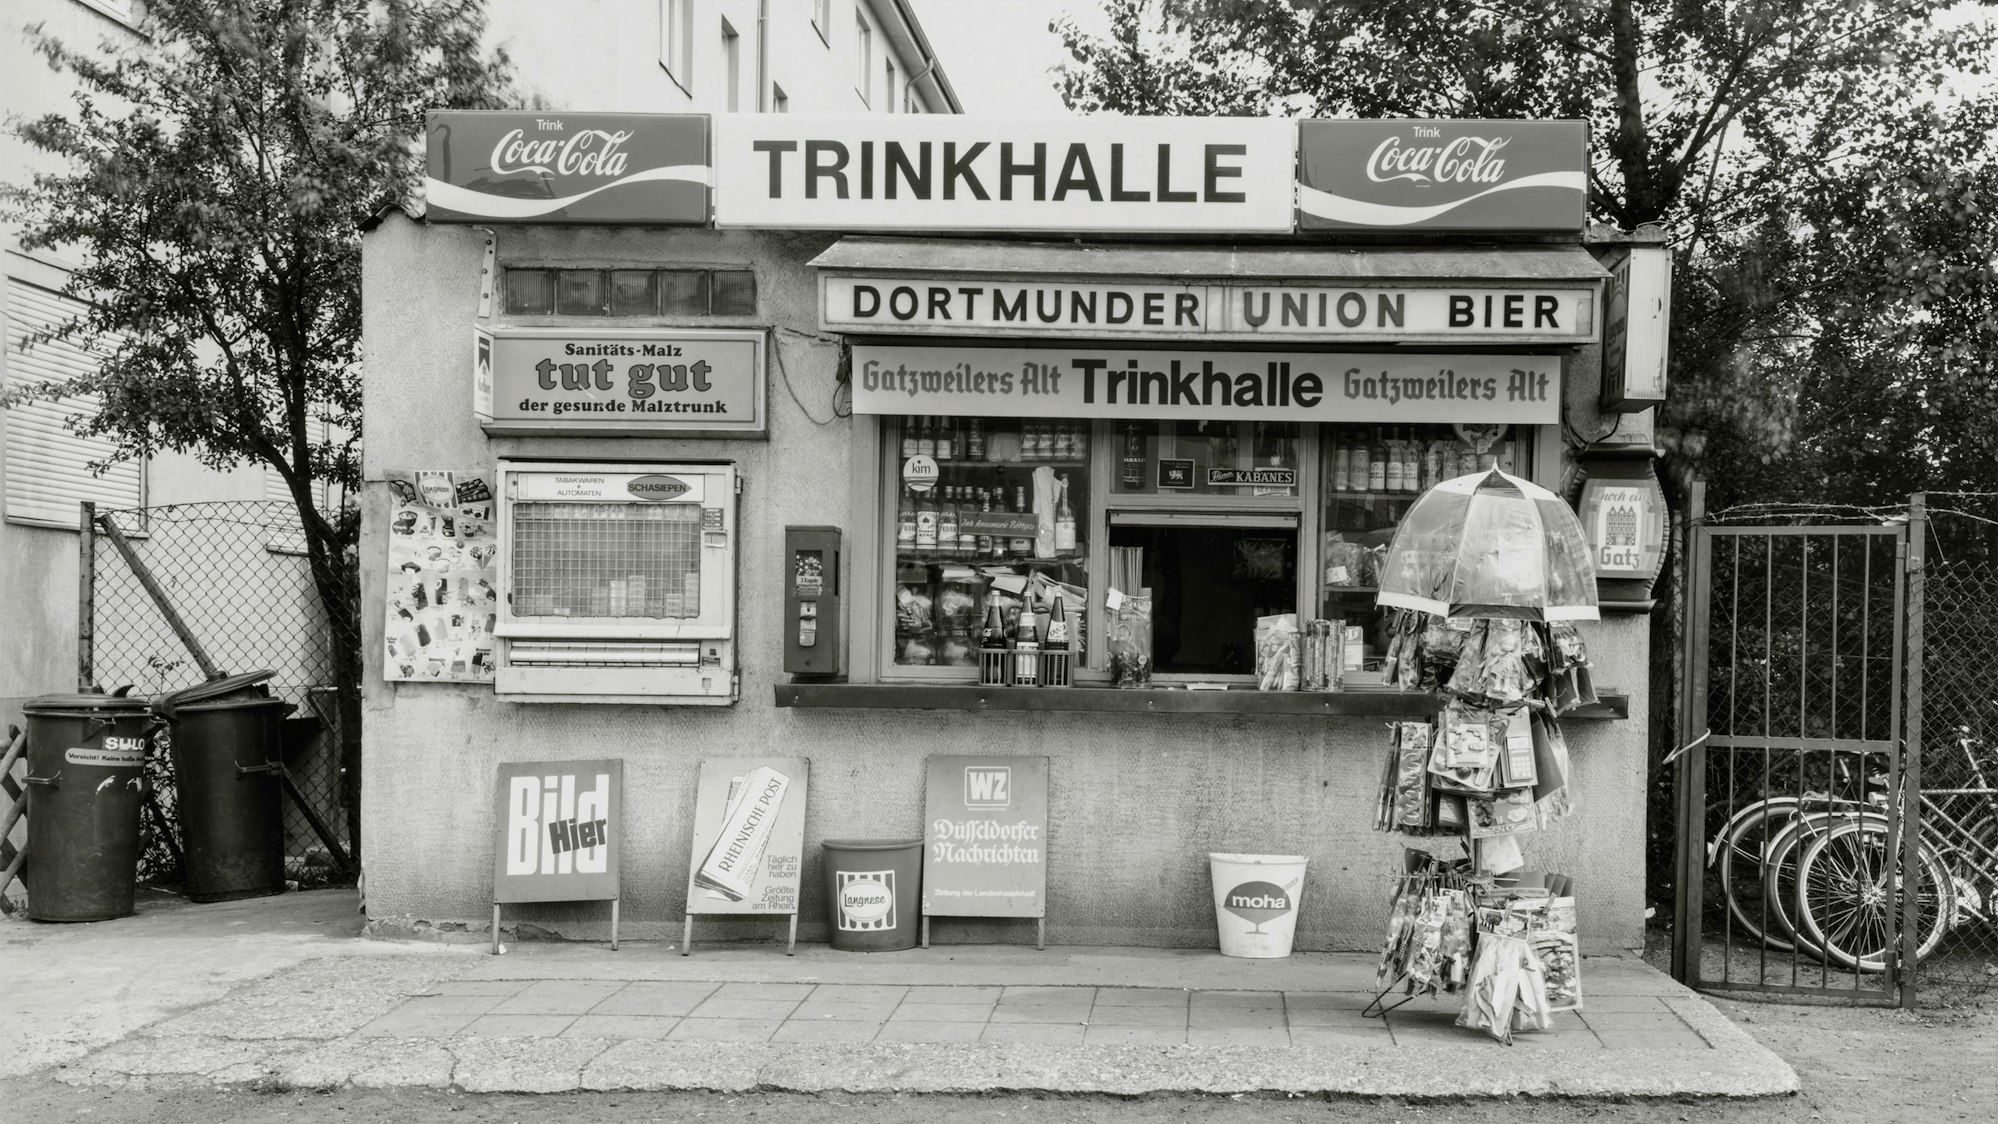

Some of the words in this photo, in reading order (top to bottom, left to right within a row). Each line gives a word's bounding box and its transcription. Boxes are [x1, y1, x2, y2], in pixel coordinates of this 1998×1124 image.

[536, 119, 564, 131] Trink
[1413, 126, 1441, 138] Trink
[490, 128, 635, 177] Coca-Cola
[1366, 136, 1512, 183] Coca-Cola
[752, 139, 1248, 204] TRINKHALLE
[852, 284, 1200, 327] DORTMUNDER
[1243, 290, 1406, 328] UNION
[1448, 293, 1561, 329] BIER
[565, 343, 682, 357] Sanitäts-Malz
[535, 358, 614, 391] tut
[627, 359, 712, 400] gut
[862, 359, 1014, 398] Gatzweilers
[1020, 361, 1062, 395] Alt
[1071, 357, 1323, 408] Trinkhalle
[1343, 366, 1497, 408] Gatzweilers
[1505, 369, 1550, 404] Alt
[519, 398, 549, 412] der
[553, 398, 626, 415] gesunde
[631, 399, 728, 414] Malztrunk
[912, 460, 931, 474] kim
[1236, 471, 1293, 483] KABÄNES
[422, 484, 451, 494] Langnese
[628, 483, 687, 492] SCHASIEPEN
[1600, 490, 1626, 502] noch
[1599, 545, 1641, 570] Gatz
[105, 737, 146, 751] SULO
[68, 752, 99, 761] Vorsicht!
[968, 771, 1007, 800] WZ
[506, 773, 610, 876] Bild
[718, 804, 765, 873] RHEINISCHE
[761, 777, 783, 808] POST
[548, 817, 607, 855] Hier
[767, 854, 798, 865] Täglich
[933, 840, 1040, 866] Nachrichten
[768, 870, 797, 878] haben
[764, 885, 795, 894] Größte
[934, 889, 961, 897] Zeitung
[974, 889, 1037, 897] Landeshauptstadt
[760, 893, 795, 904] Zeitung
[844, 893, 886, 908] Langnese
[1232, 894, 1286, 909] moha
